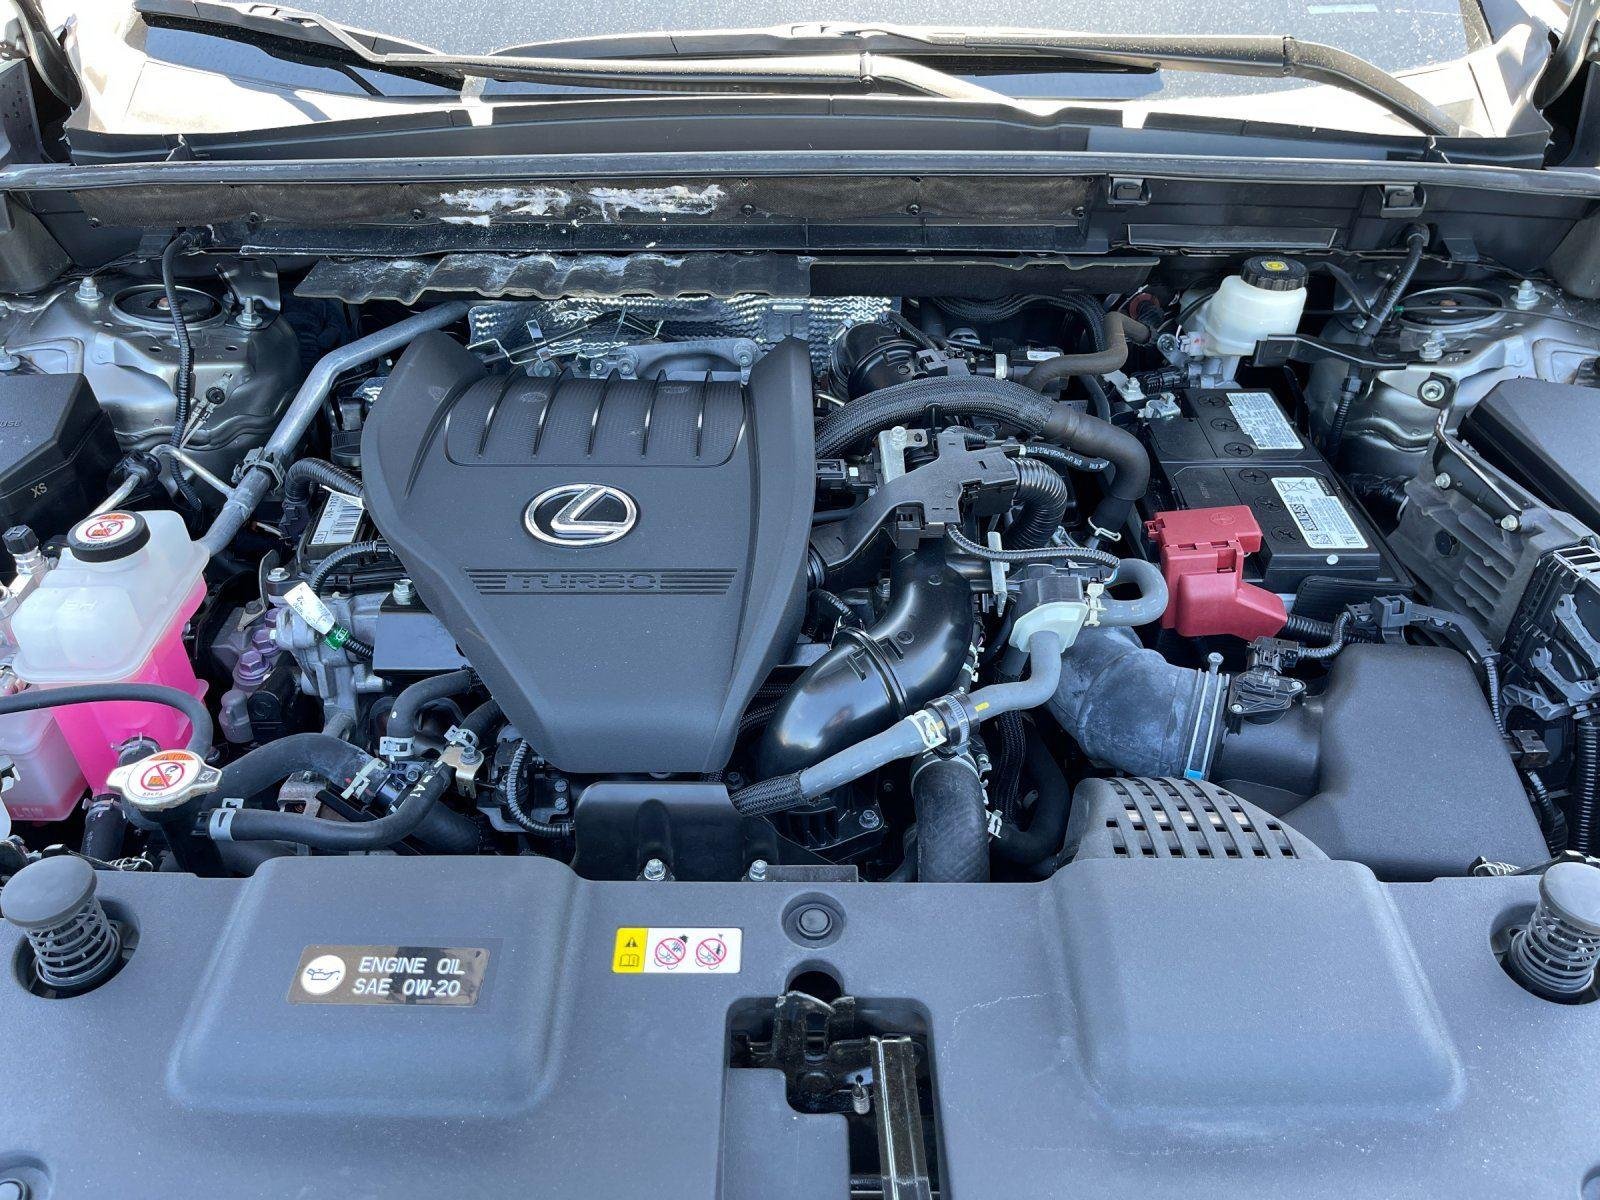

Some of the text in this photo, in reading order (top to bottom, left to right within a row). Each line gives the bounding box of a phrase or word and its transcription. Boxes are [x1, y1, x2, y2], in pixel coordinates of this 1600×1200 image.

[512, 573, 656, 589] TURBO
[358, 956, 466, 975] ENGINE OIL
[352, 977, 461, 997] SAE 0W-20
